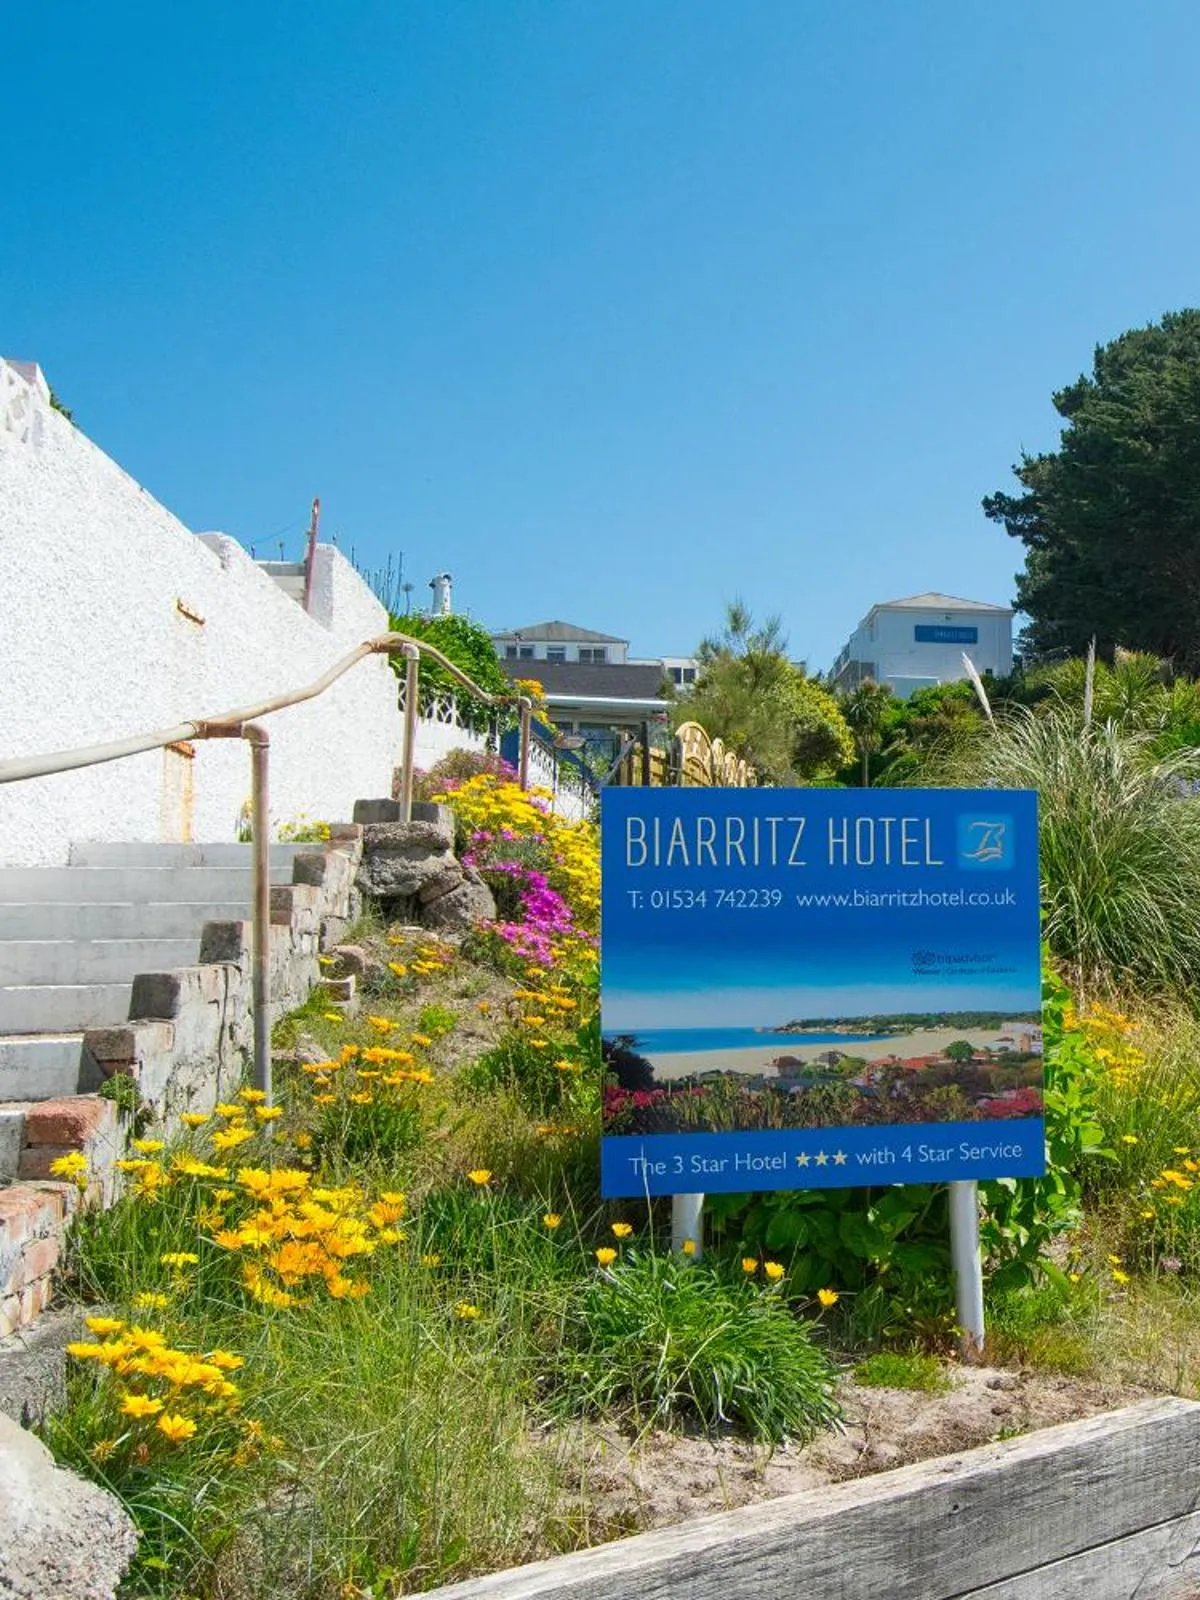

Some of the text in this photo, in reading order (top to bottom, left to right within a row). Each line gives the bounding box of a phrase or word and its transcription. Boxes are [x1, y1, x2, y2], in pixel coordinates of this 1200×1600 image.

[626, 816, 944, 866] BIARRITZ HOTEL
[627, 887, 1017, 909] T: 01534 742239 www.biarritzhotel.co.uk
[628, 1141, 1022, 1176] The 3 Star Hotel with 4 Star Service
